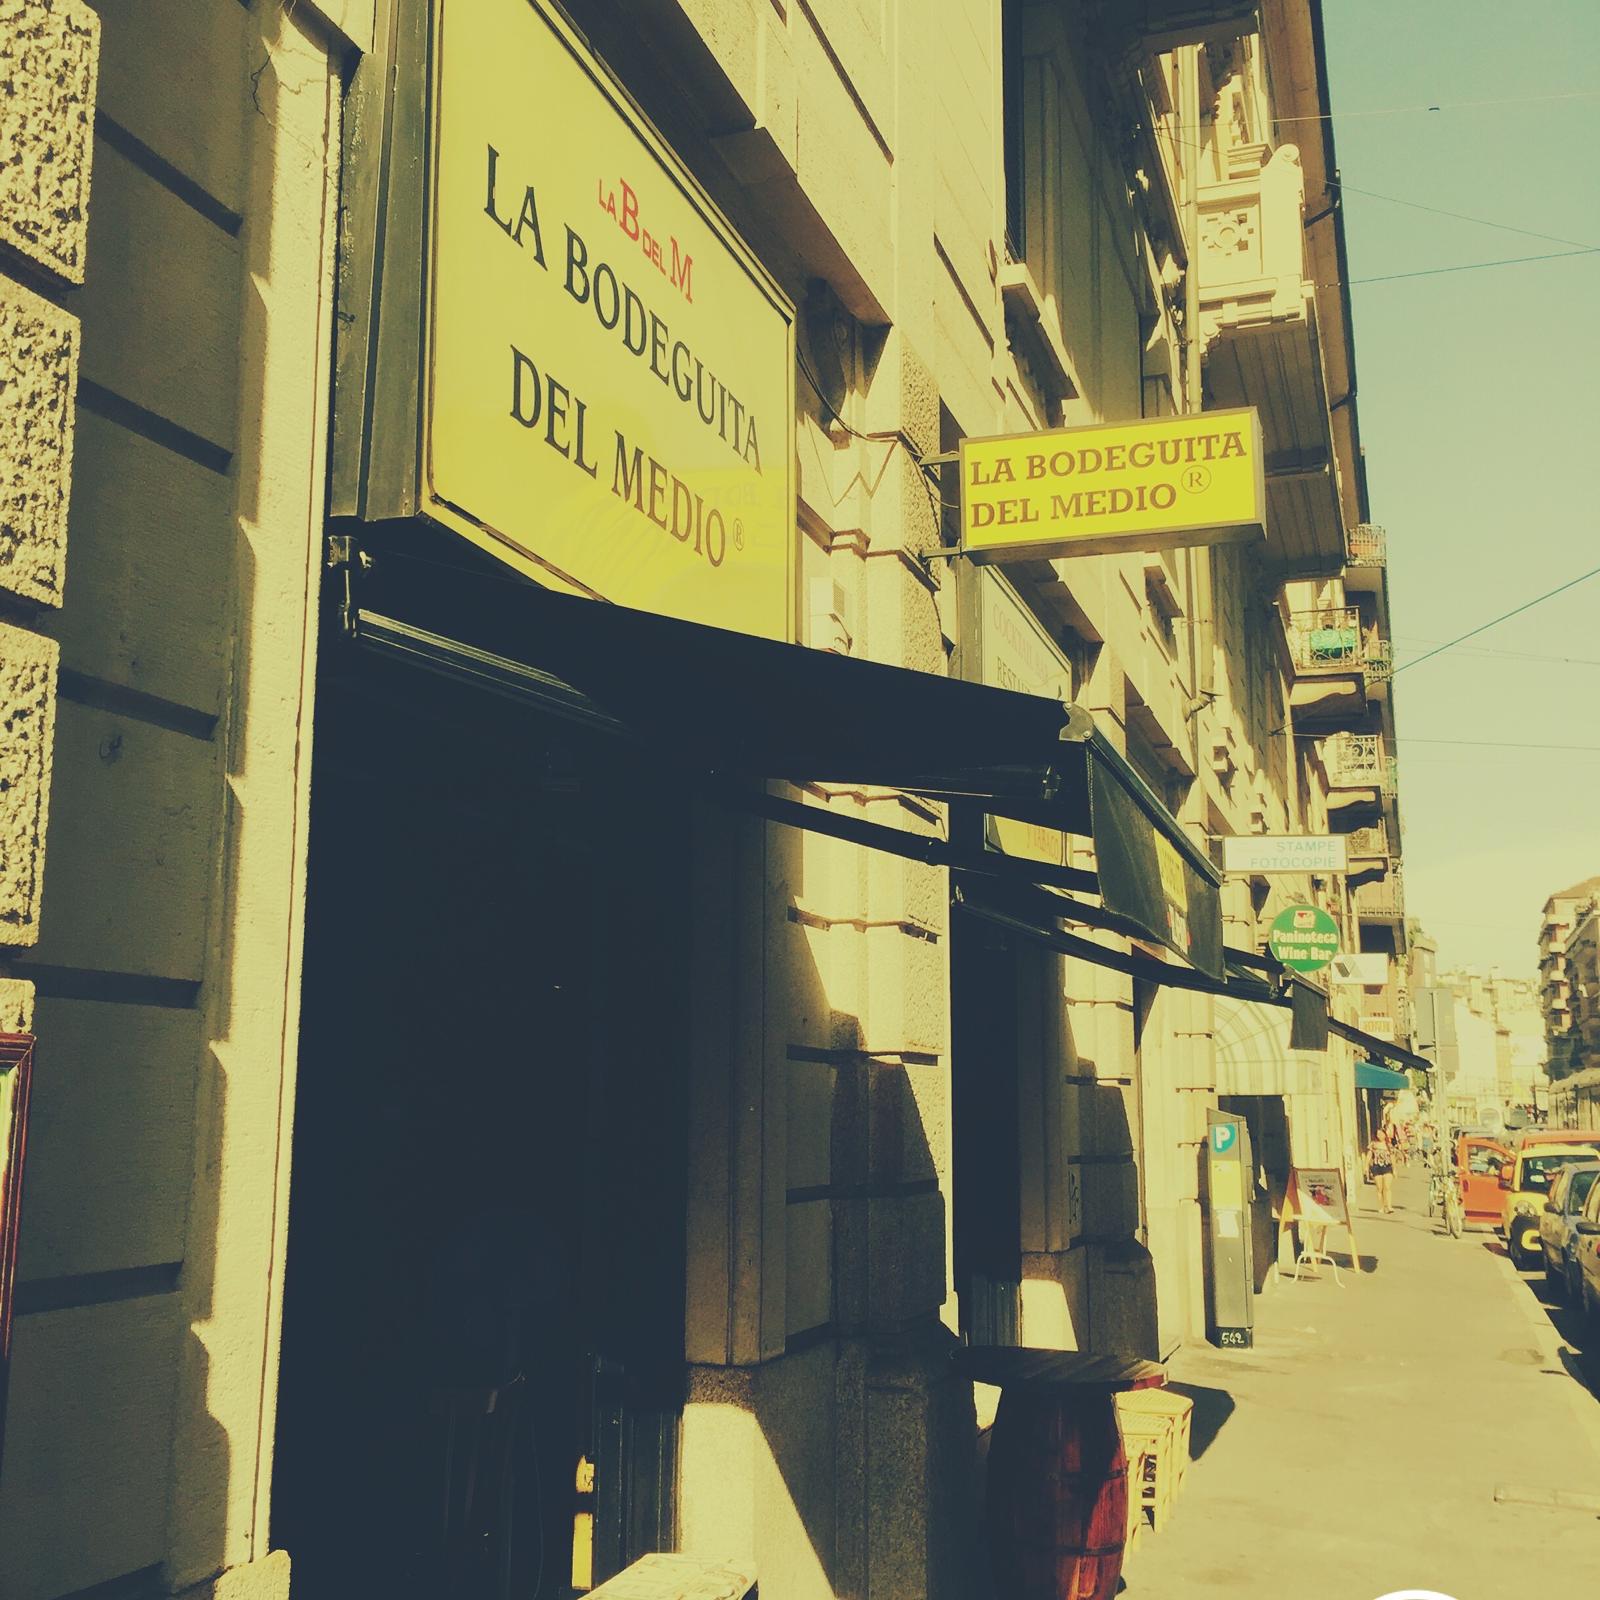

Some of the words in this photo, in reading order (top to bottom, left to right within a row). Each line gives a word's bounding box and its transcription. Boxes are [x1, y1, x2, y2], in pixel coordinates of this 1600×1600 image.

[642, 228, 666, 276] DEL
[670, 235, 693, 304] M
[484, 144, 548, 271] LA
[563, 222, 763, 477] BODEGUITA
[510, 345, 597, 479] DEL
[612, 430, 726, 568] MEDIO
[970, 457, 1016, 486] LA
[1026, 431, 1247, 480] BODEGUITA
[971, 498, 1039, 528] DEL
[1051, 483, 1177, 520] MEDIO
[1251, 856, 1336, 868] FOTOCOPIE
[1276, 841, 1336, 853] STAMPE
[1278, 946, 1307, 960] Wine
[1311, 946, 1332, 960] Bar
[1215, 1126, 1231, 1149] P
